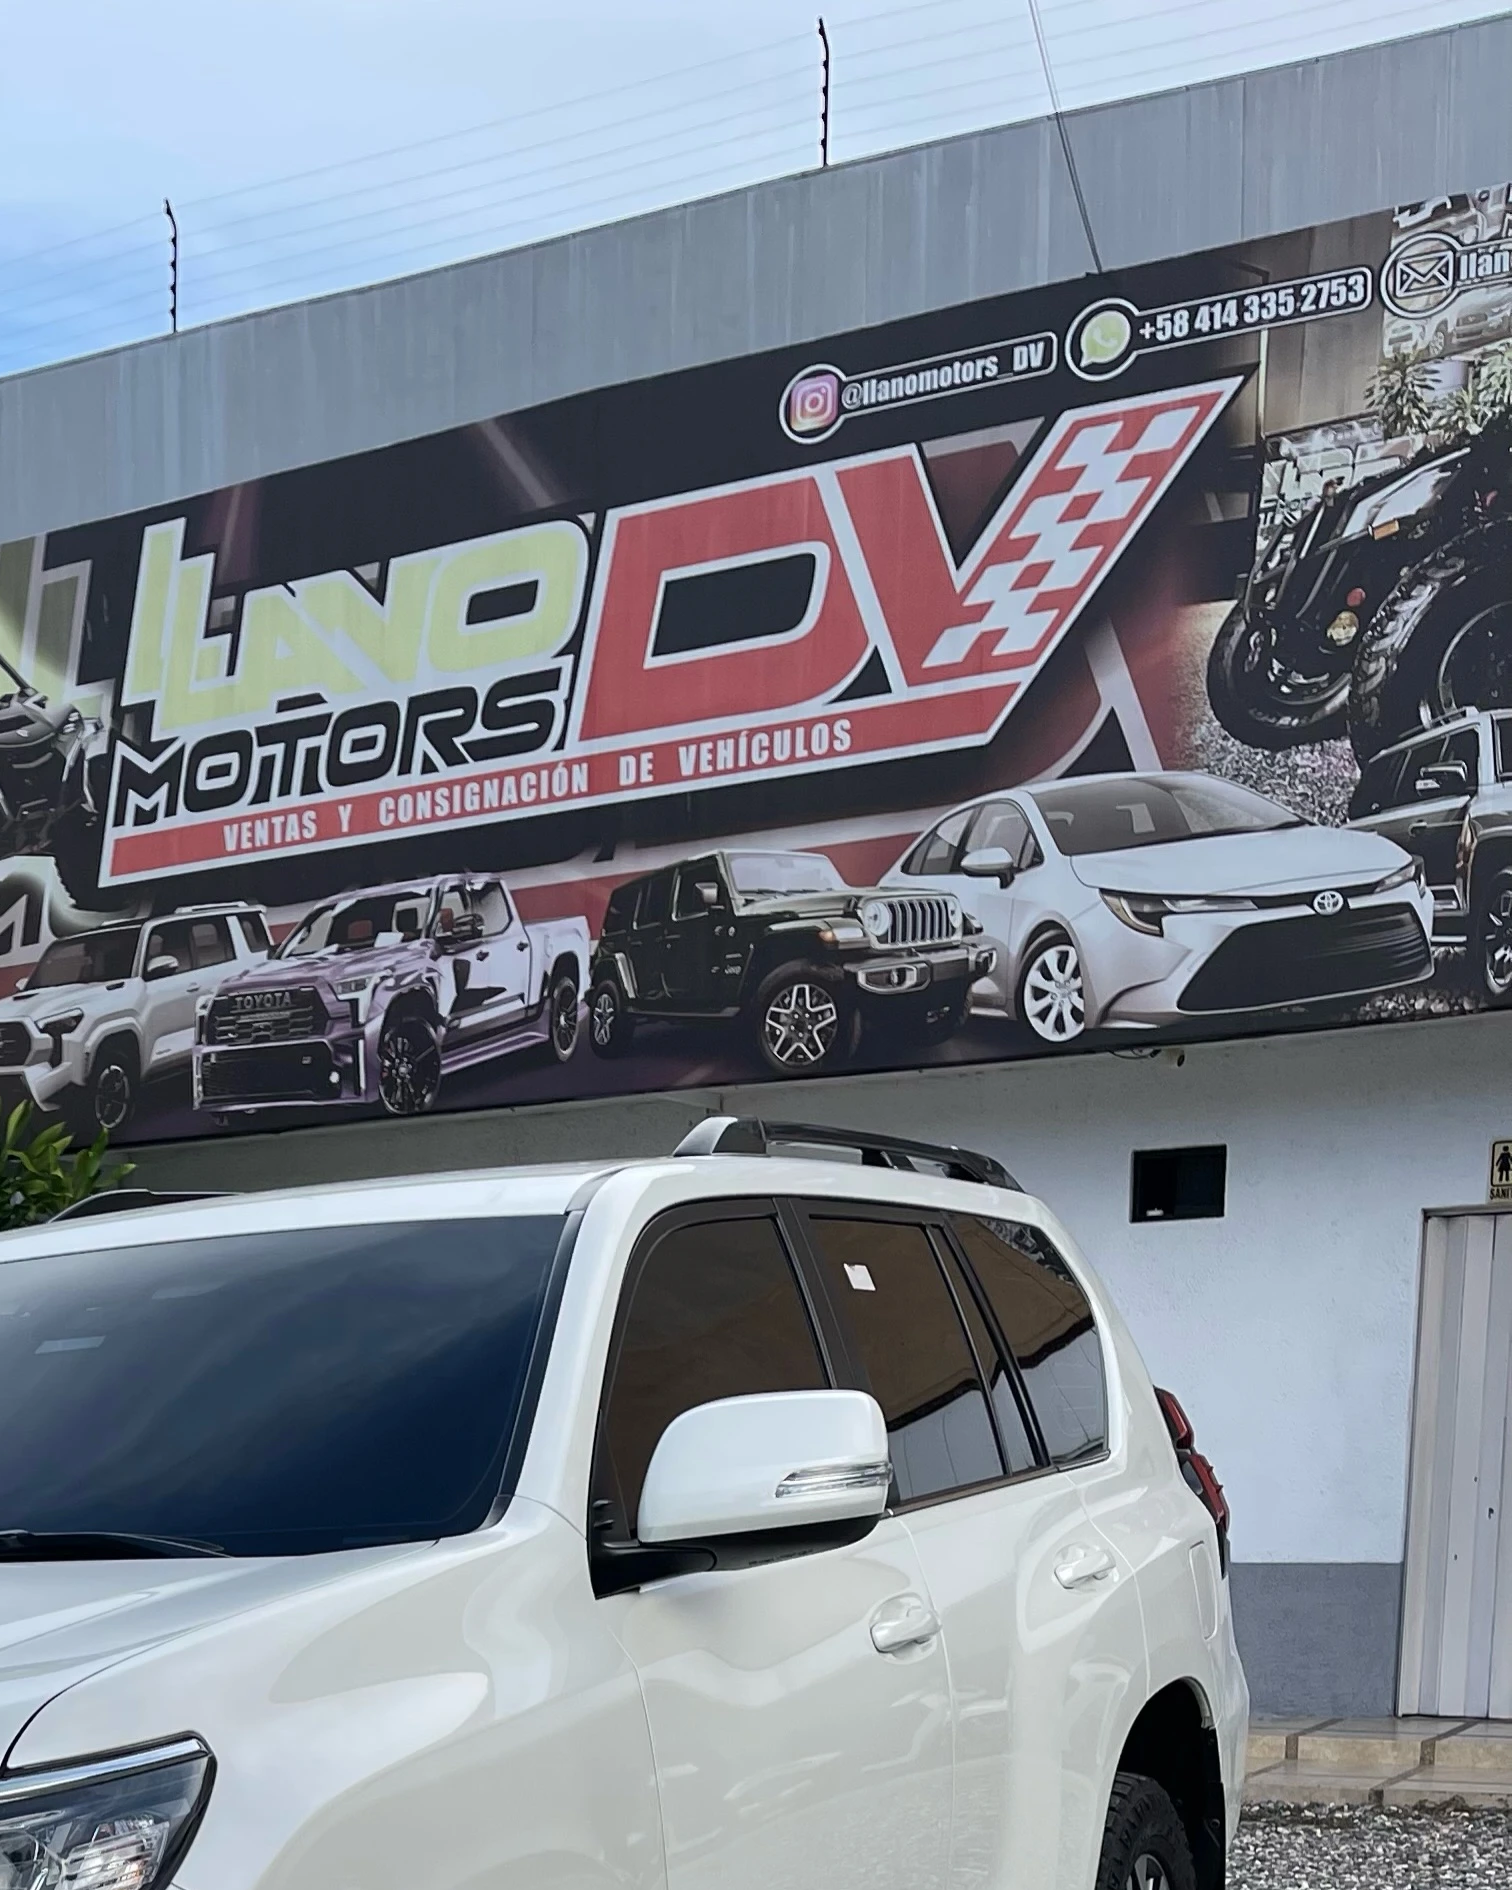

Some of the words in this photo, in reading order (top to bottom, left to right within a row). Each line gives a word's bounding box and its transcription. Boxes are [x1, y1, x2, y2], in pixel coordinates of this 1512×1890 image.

[841, 341, 1046, 410] @llanomotors_DV
[1139, 309, 1189, 342] +58
[1194, 299, 1238, 333] 414
[123, 518, 588, 732] LLANO
[579, 376, 1243, 741] DV
[112, 667, 566, 828] MOTORS
[223, 811, 318, 852] VENTAS
[337, 804, 353, 833] Y
[377, 762, 589, 827] CONSIGNACIÓN
[618, 752, 654, 786] DE
[678, 718, 853, 779] VEHÍCULOS
[235, 992, 292, 1010] TOYOTA
